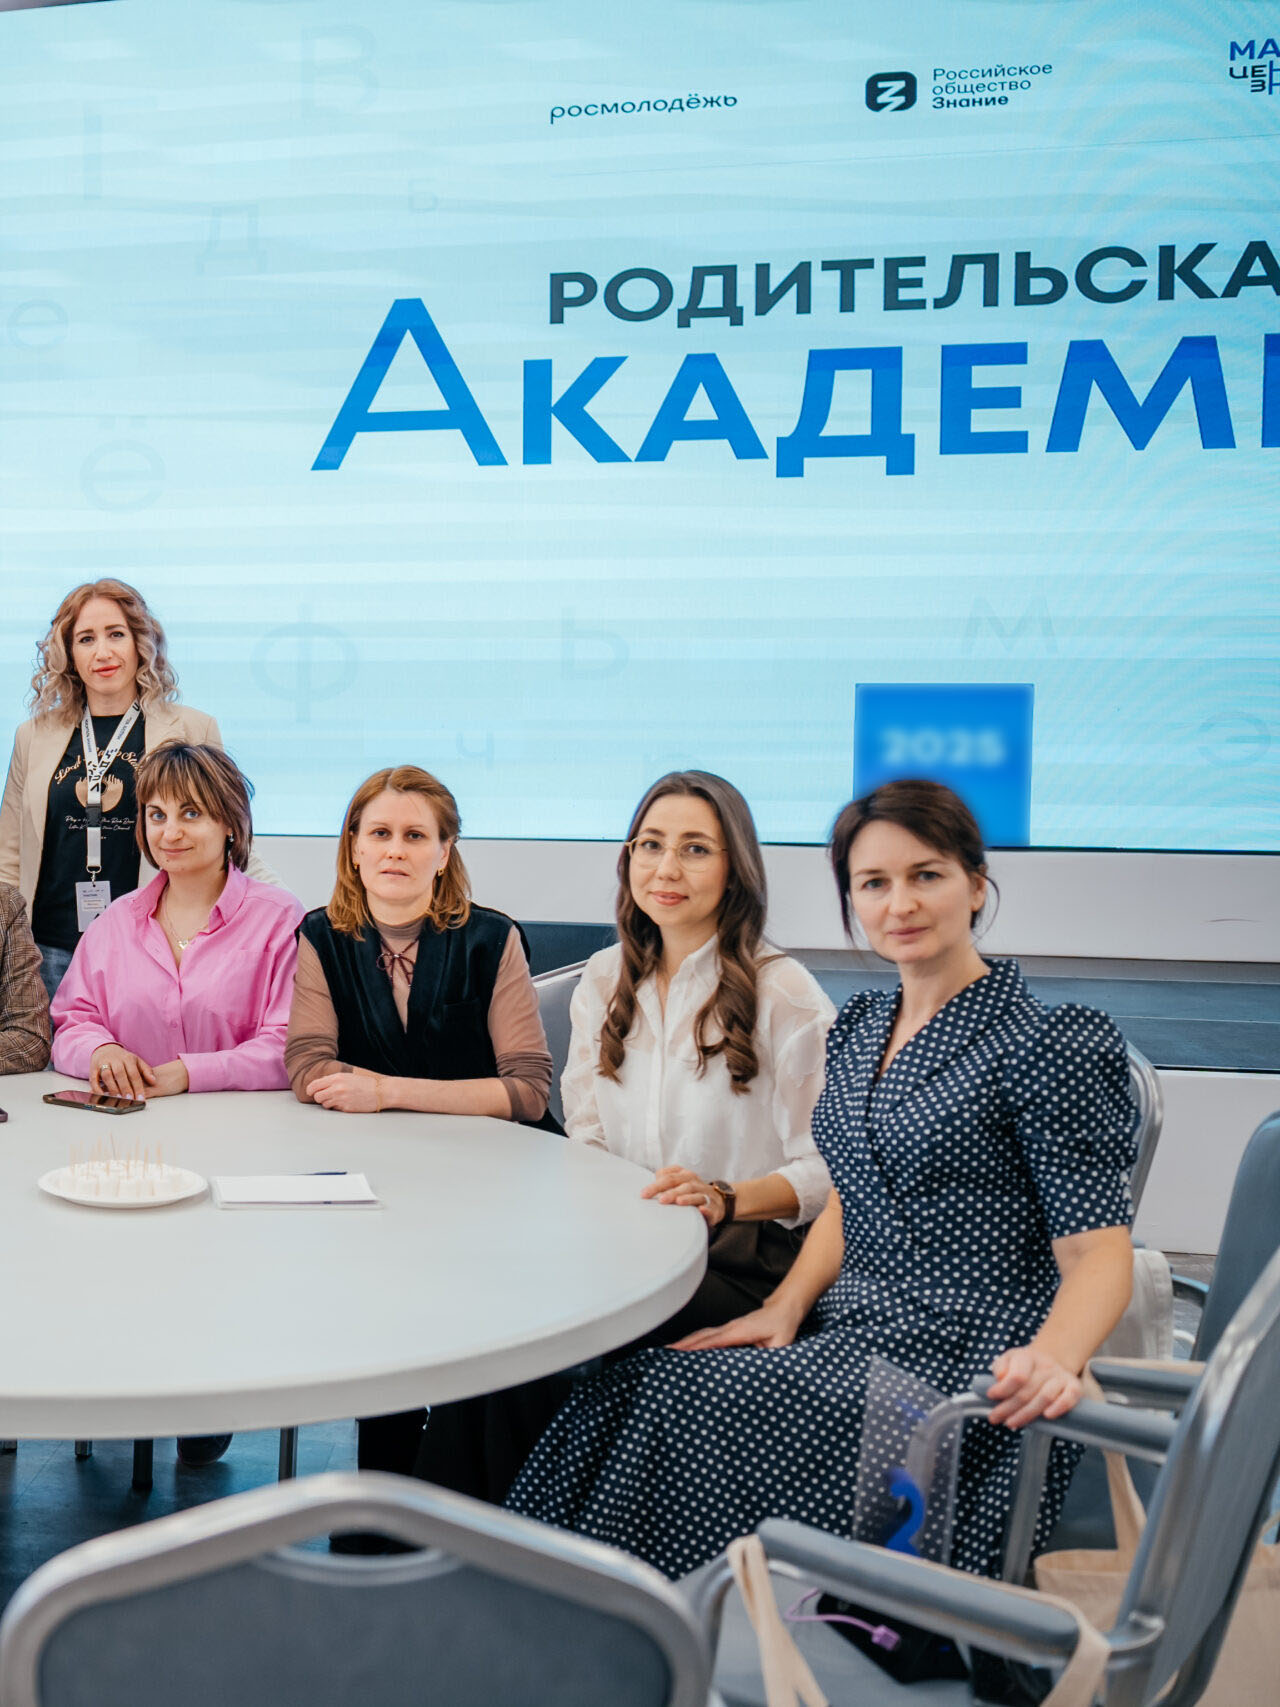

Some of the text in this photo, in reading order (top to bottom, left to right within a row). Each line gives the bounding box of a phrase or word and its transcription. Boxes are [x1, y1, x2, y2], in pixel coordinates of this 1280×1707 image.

[1230, 38, 1280, 61] МА
[933, 64, 1053, 81] Российское
[932, 79, 1031, 95] общество
[550, 91, 738, 124] росмолодёжь
[932, 95, 1009, 109] Знание
[549, 240, 1280, 328] РОДИТЕЛЬСКА
[311, 298, 1280, 478] АКАДЕМ
[883, 729, 1004, 767] 2025
